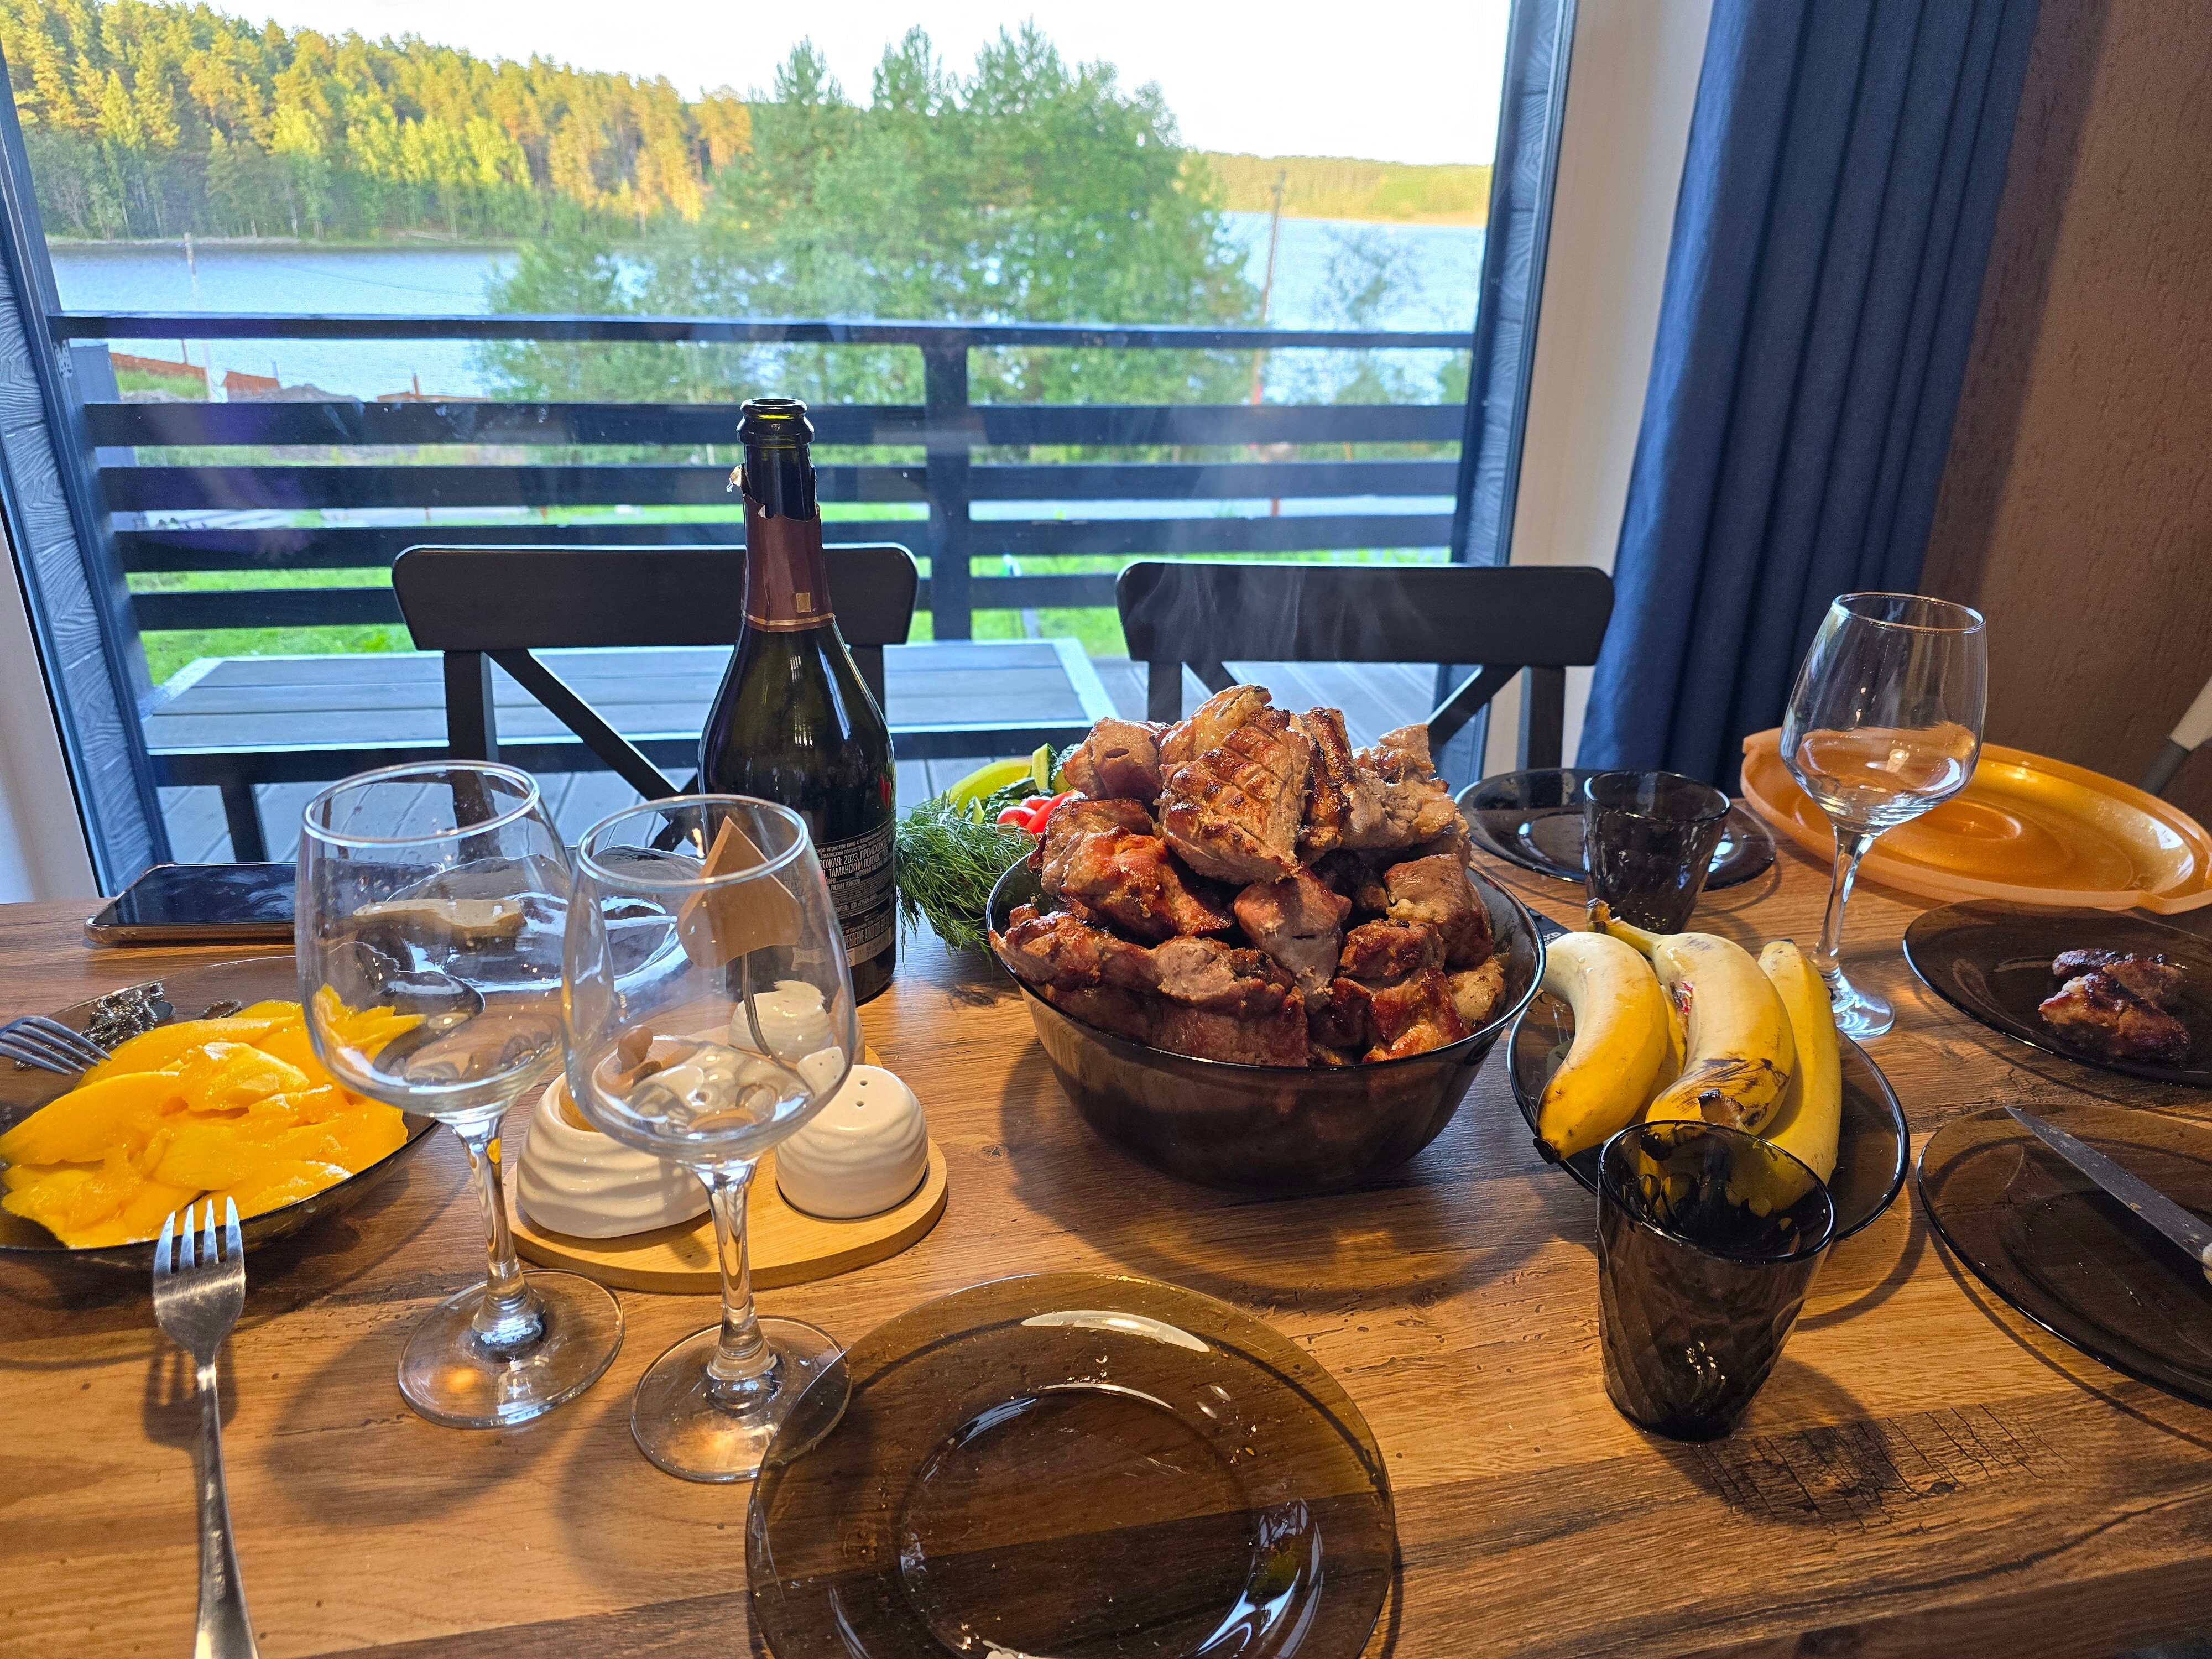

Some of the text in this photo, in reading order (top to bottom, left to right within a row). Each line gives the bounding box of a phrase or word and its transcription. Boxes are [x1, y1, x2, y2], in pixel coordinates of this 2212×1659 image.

[820, 851, 843, 859] Таманский
[844, 843, 867, 855] полуостров
[826, 844, 846, 852] игристое
[819, 858, 843, 869] РОЖАЯ:
[830, 859, 863, 878] ТАМАНСКИЙ
